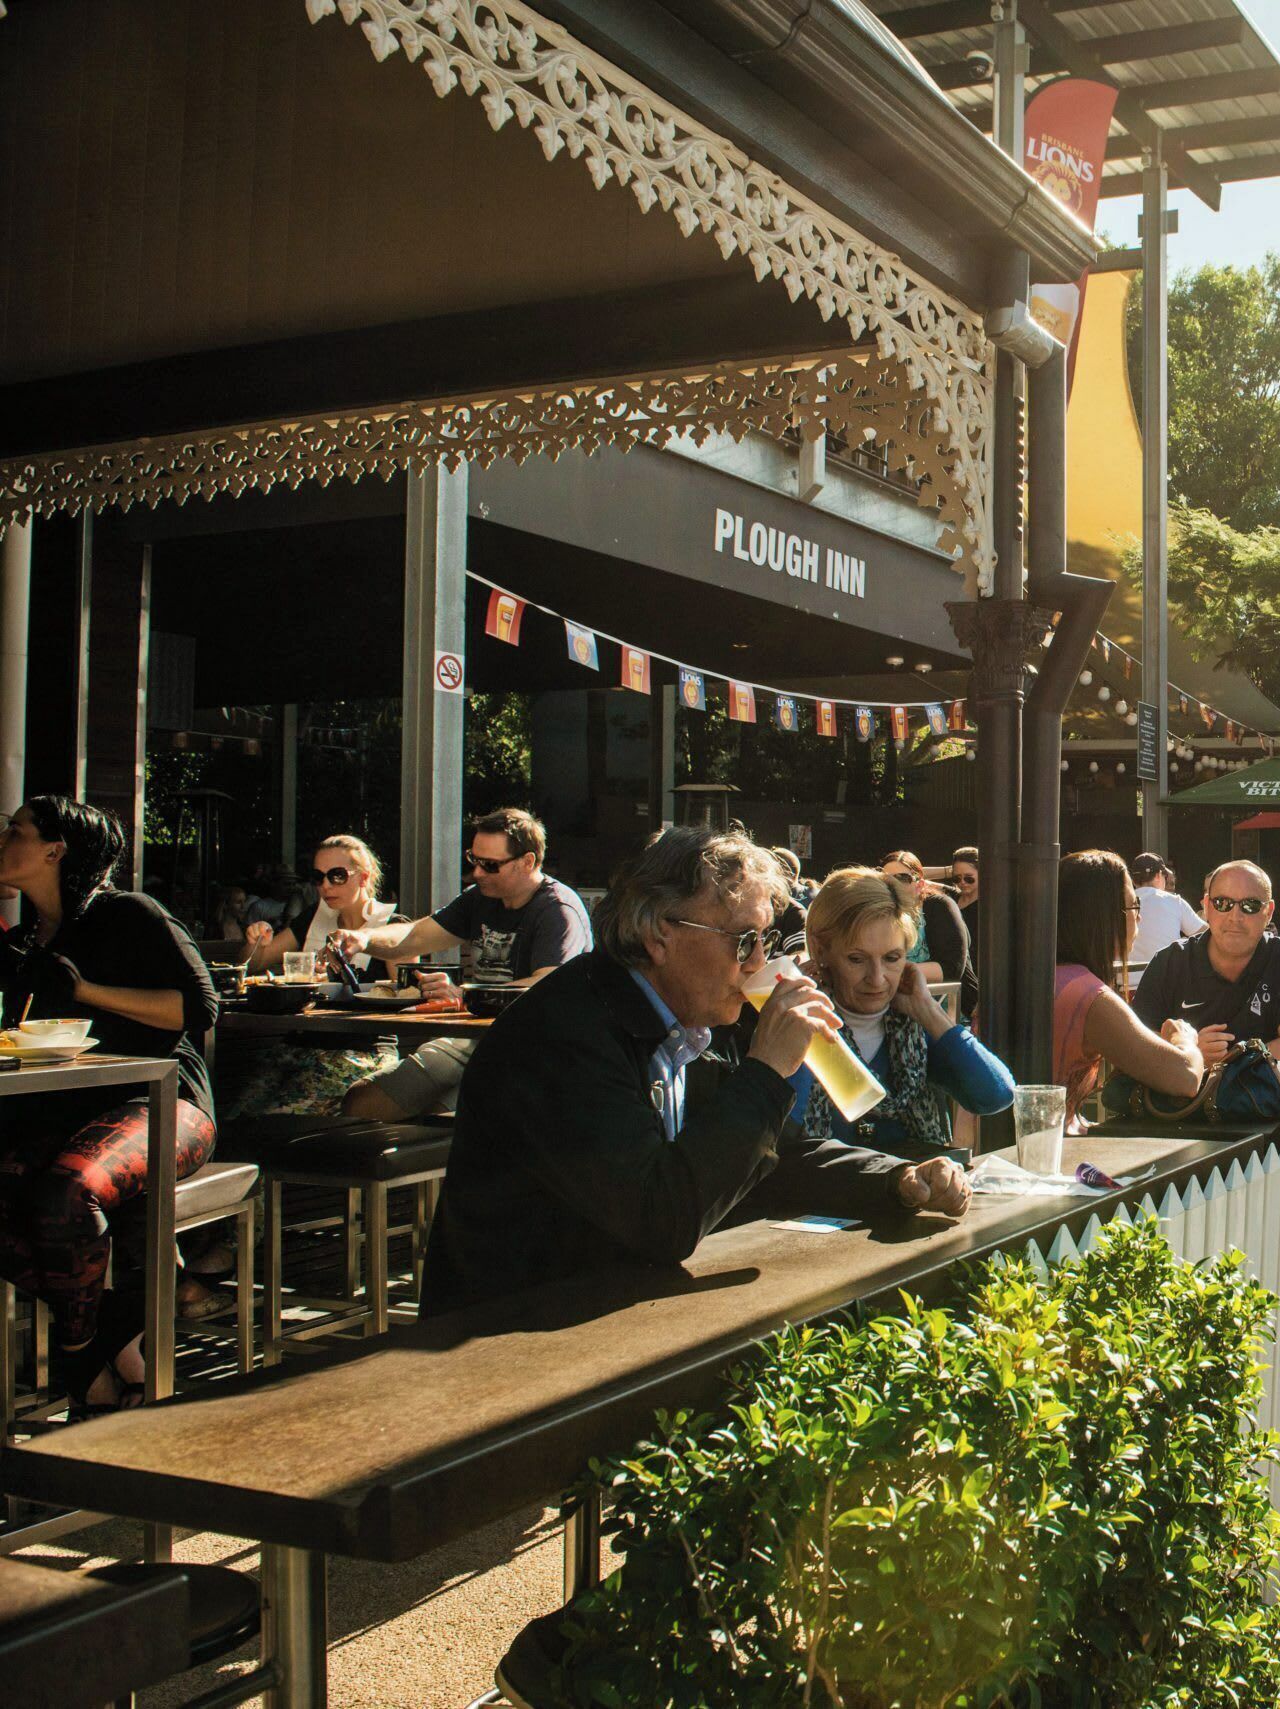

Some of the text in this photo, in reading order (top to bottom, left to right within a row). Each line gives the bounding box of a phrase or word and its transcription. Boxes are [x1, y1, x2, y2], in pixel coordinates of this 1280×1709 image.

[1027, 136, 1094, 183] LIONS
[1041, 133, 1085, 158] BRISBANE
[715, 508, 865, 598] PLOUGH INN
